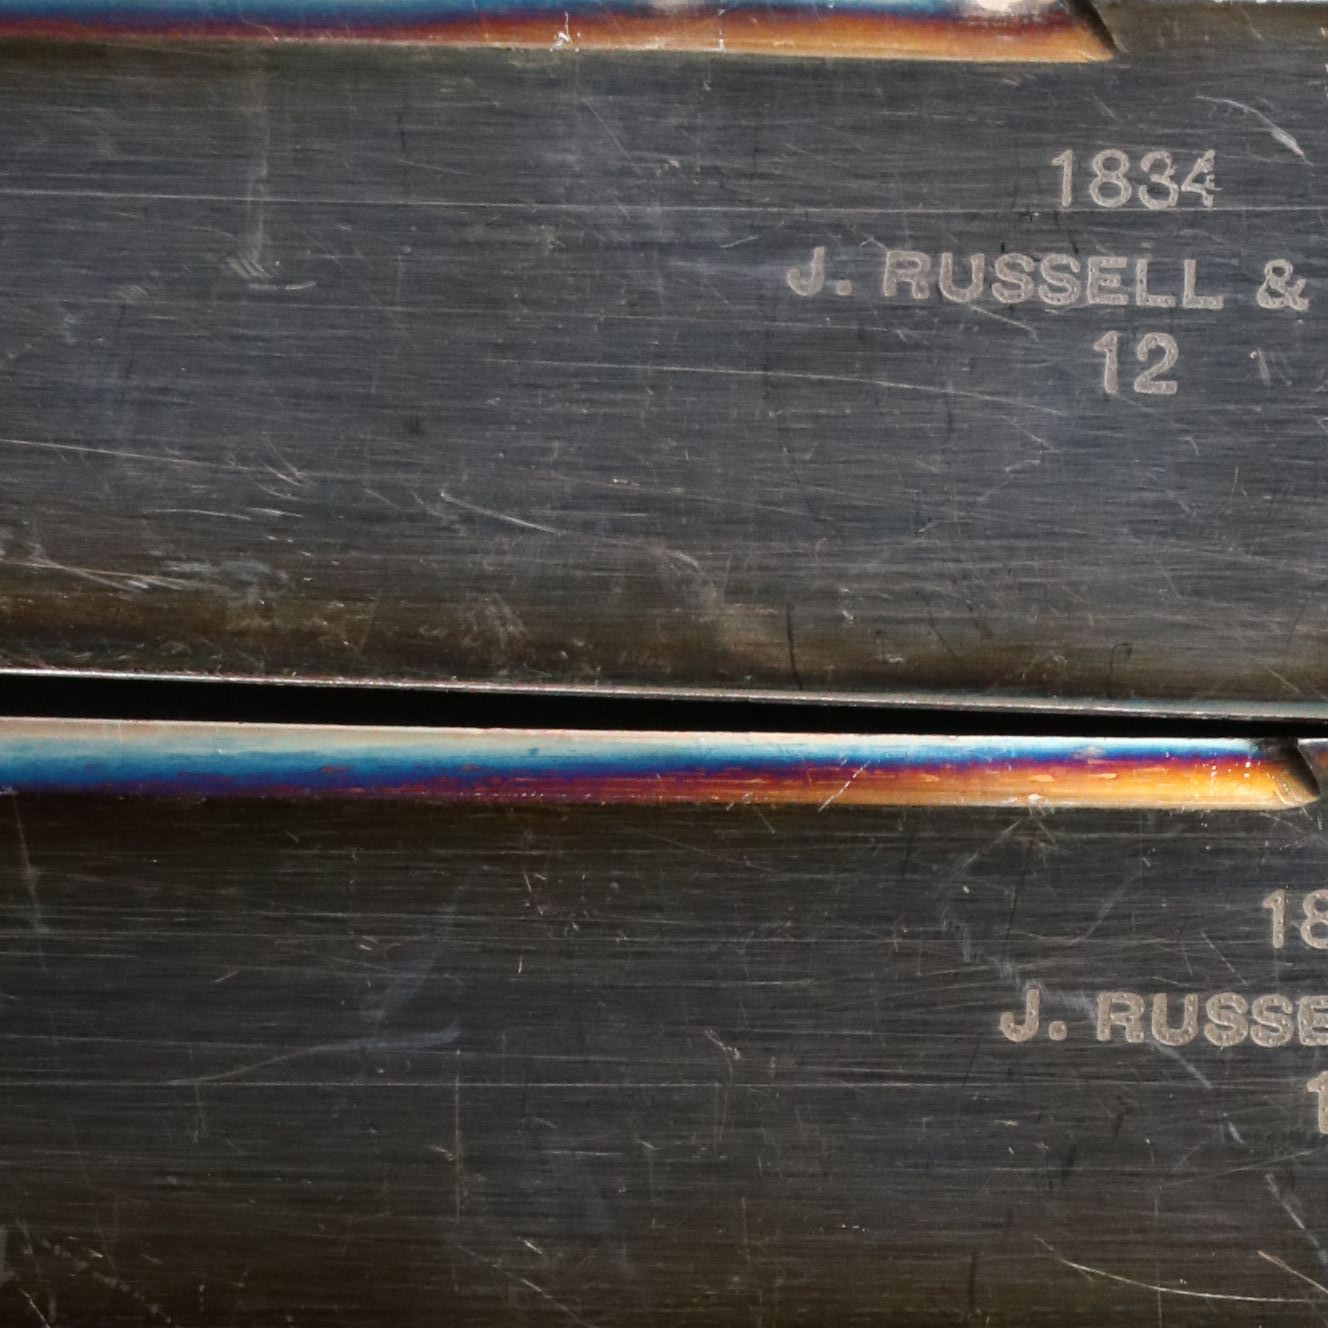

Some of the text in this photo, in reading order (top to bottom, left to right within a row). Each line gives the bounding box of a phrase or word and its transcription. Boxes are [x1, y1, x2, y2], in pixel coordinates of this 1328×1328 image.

[1051, 149, 1222, 209] 1834
[787, 247, 852, 297] J.
[883, 250, 1224, 310] RUSSELL
[1257, 258, 1309, 310] &
[1094, 330, 1178, 395] 12
[1001, 988, 1067, 1042] J.
